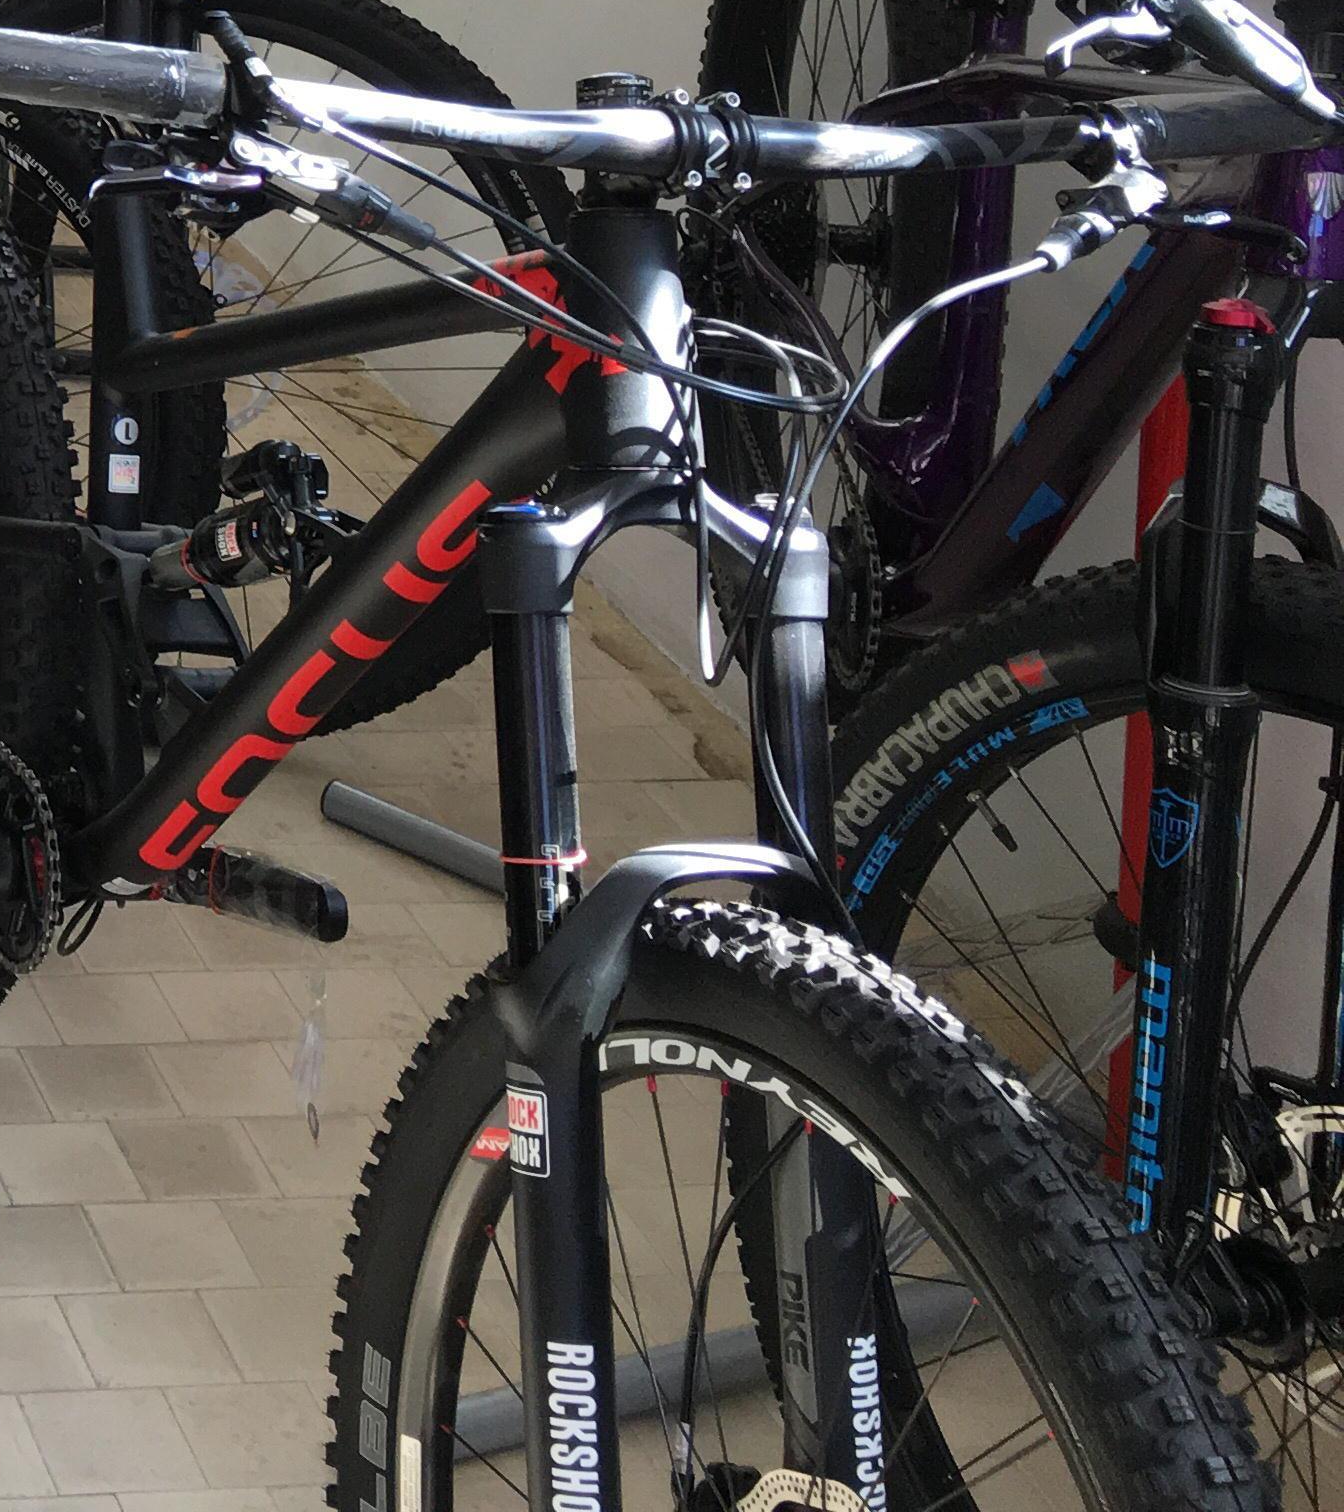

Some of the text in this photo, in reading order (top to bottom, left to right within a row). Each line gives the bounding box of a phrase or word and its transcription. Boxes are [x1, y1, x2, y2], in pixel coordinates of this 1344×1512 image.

[832, 663, 1022, 849] CHUPACABRA
[507, 1095, 540, 1131] OCK
[509, 1134, 542, 1169] HOX
[599, 1034, 914, 1200] REYNOL
[1124, 958, 1173, 1236] manito
[780, 1269, 812, 1374] PIKE
[546, 1340, 601, 1512] ROCKSHO
